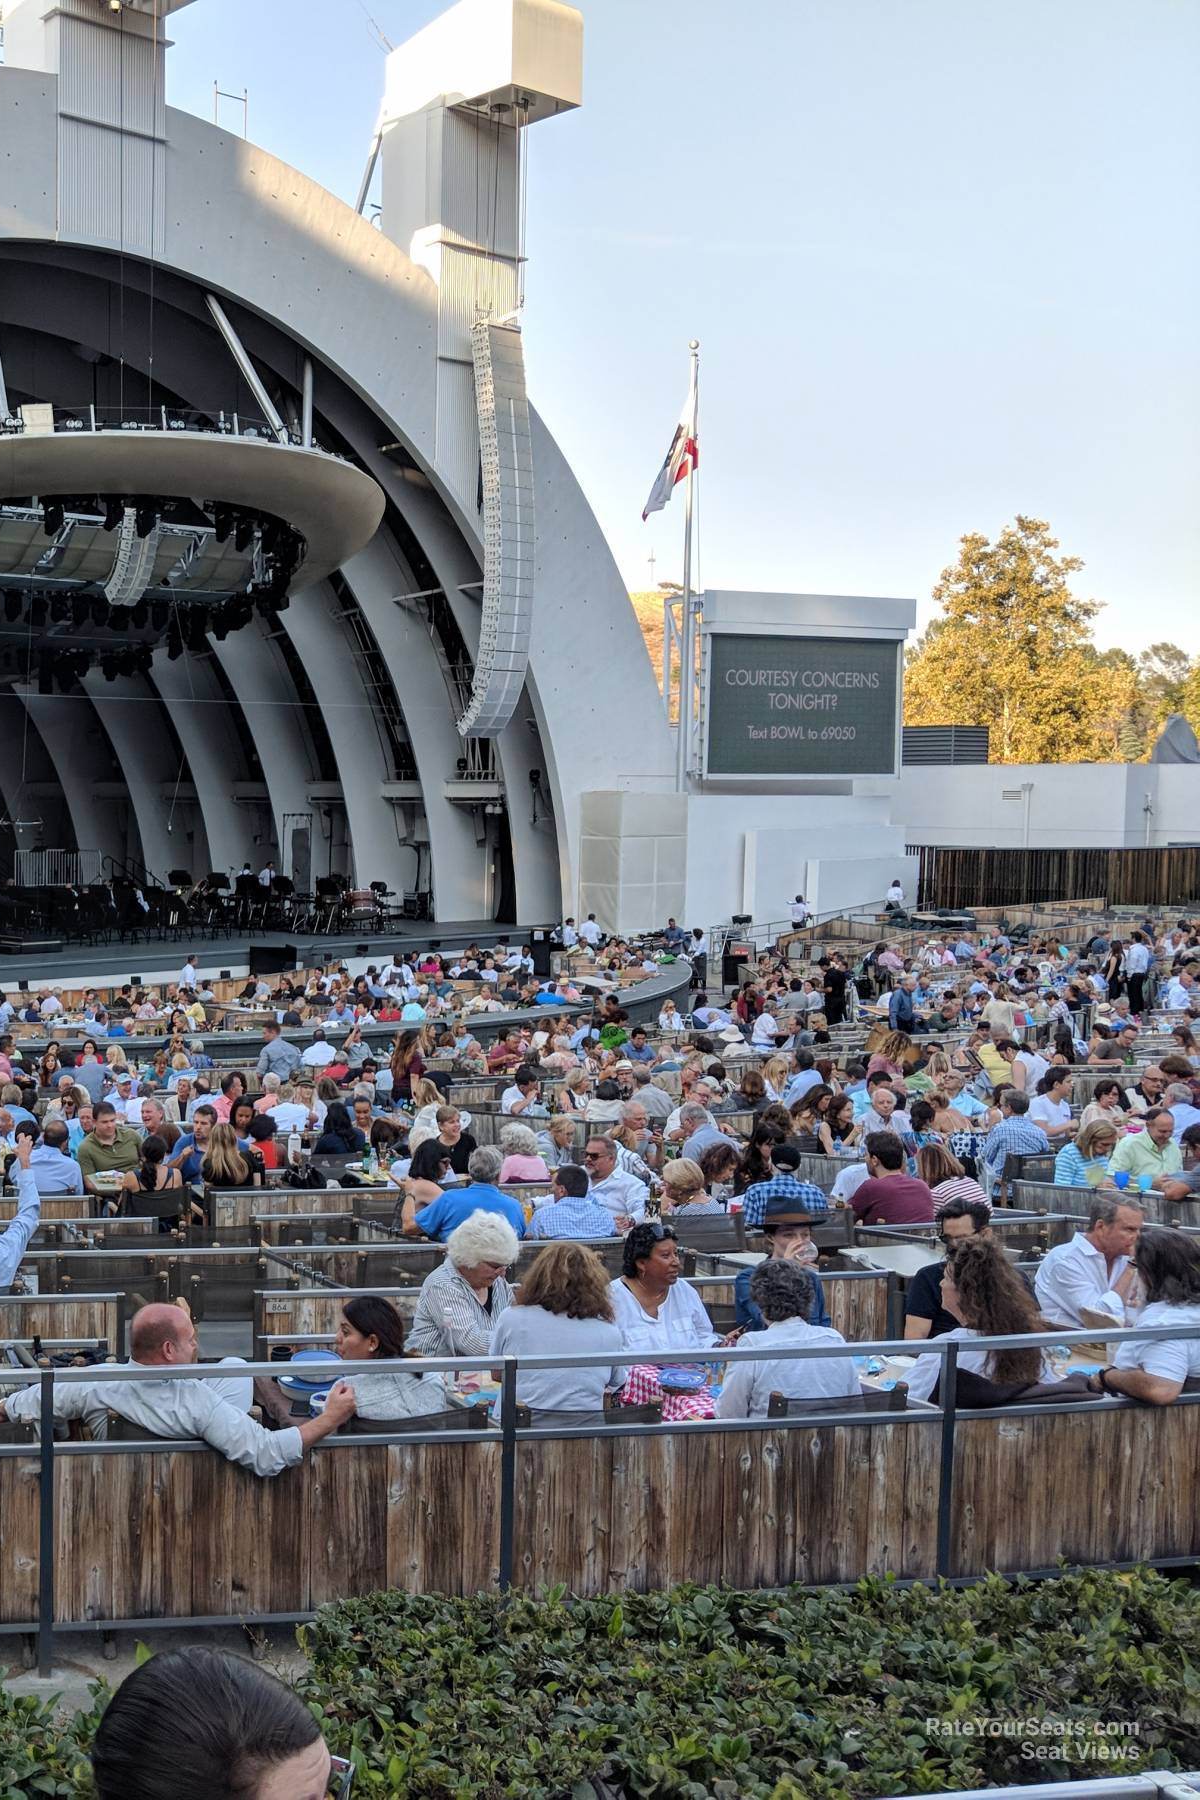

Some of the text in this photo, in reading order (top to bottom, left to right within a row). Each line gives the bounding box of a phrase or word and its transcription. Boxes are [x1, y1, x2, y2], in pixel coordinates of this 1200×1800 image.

[725, 669, 880, 689] COURTESY CONCERNS
[768, 693, 838, 710] TONIGHT?
[748, 725, 856, 741] Text BOWL to 69050
[271, 1303, 287, 1312] 864
